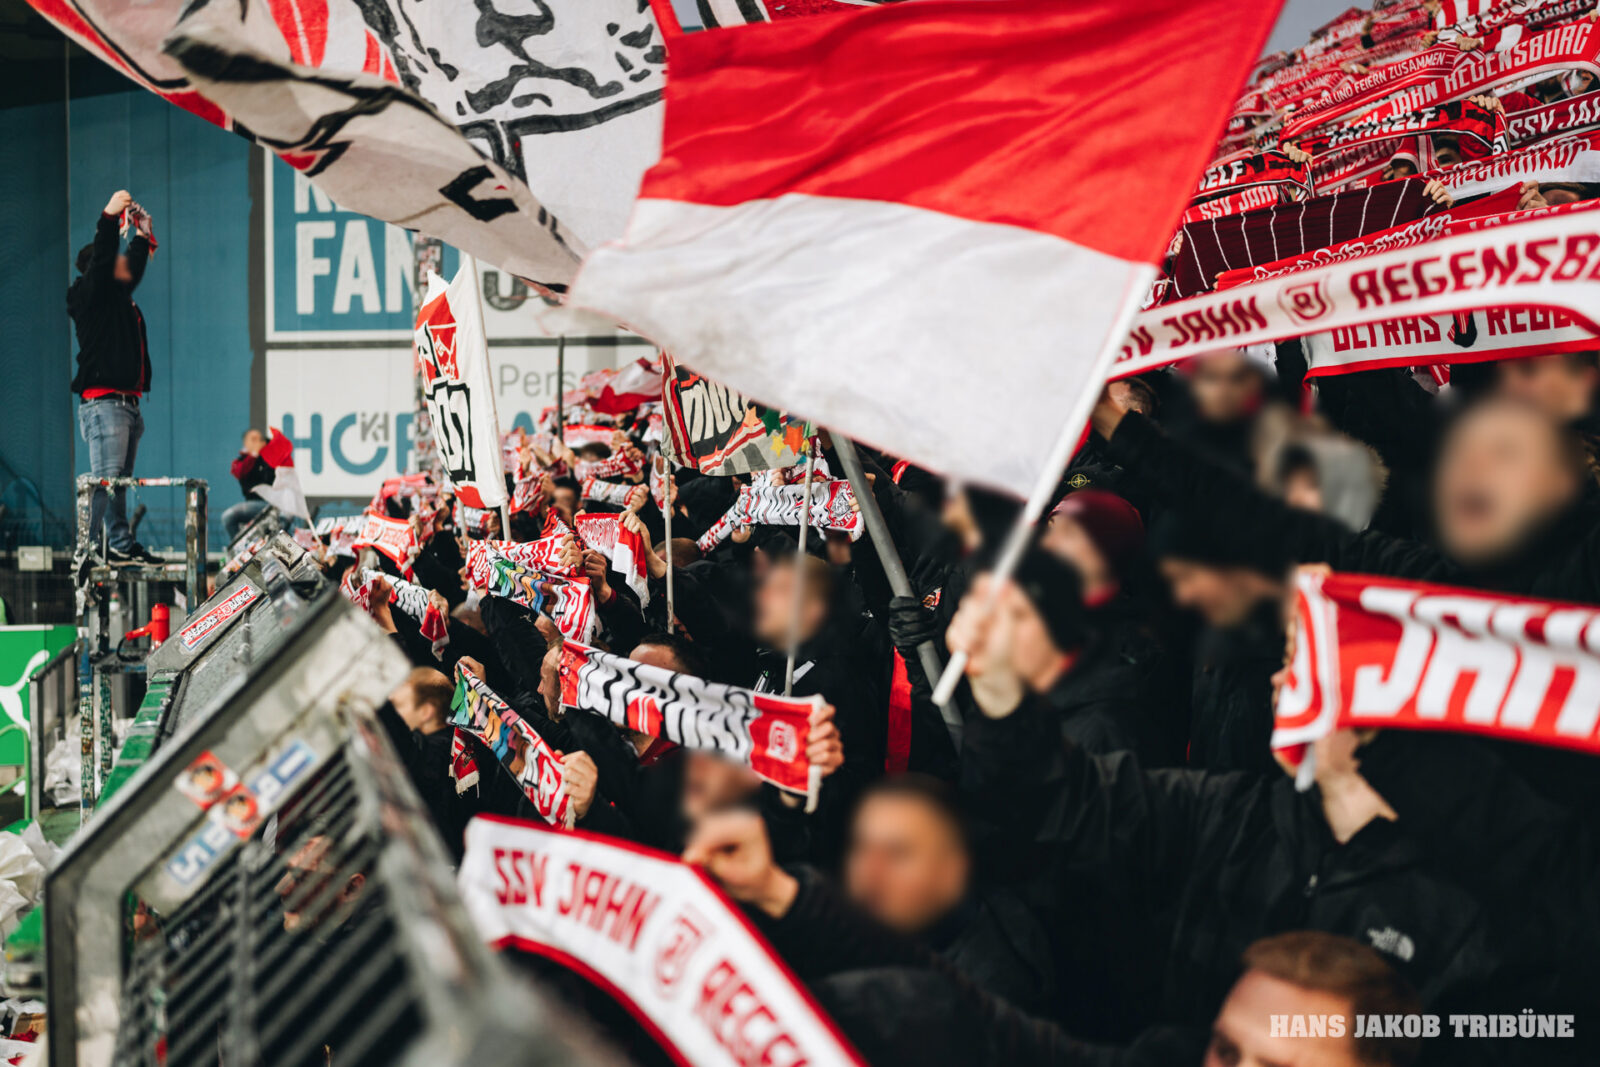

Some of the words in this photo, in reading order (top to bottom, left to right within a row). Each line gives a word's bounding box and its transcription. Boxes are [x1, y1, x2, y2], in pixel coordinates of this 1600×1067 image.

[1354, 71, 1388, 93] FEIERN
[1388, 52, 1446, 79] ZUSAMMEN
[1508, 109, 1556, 145] SSV
[1557, 97, 1600, 130] JA
[1199, 160, 1244, 191] ELF
[1200, 195, 1232, 220] SSV
[1163, 296, 1268, 348] JAHN
[1350, 233, 1600, 309] REGENSB
[499, 364, 580, 398] Pers
[1351, 586, 1600, 738] JAH
[493, 848, 547, 907] SSV
[558, 863, 660, 952] JAHN
